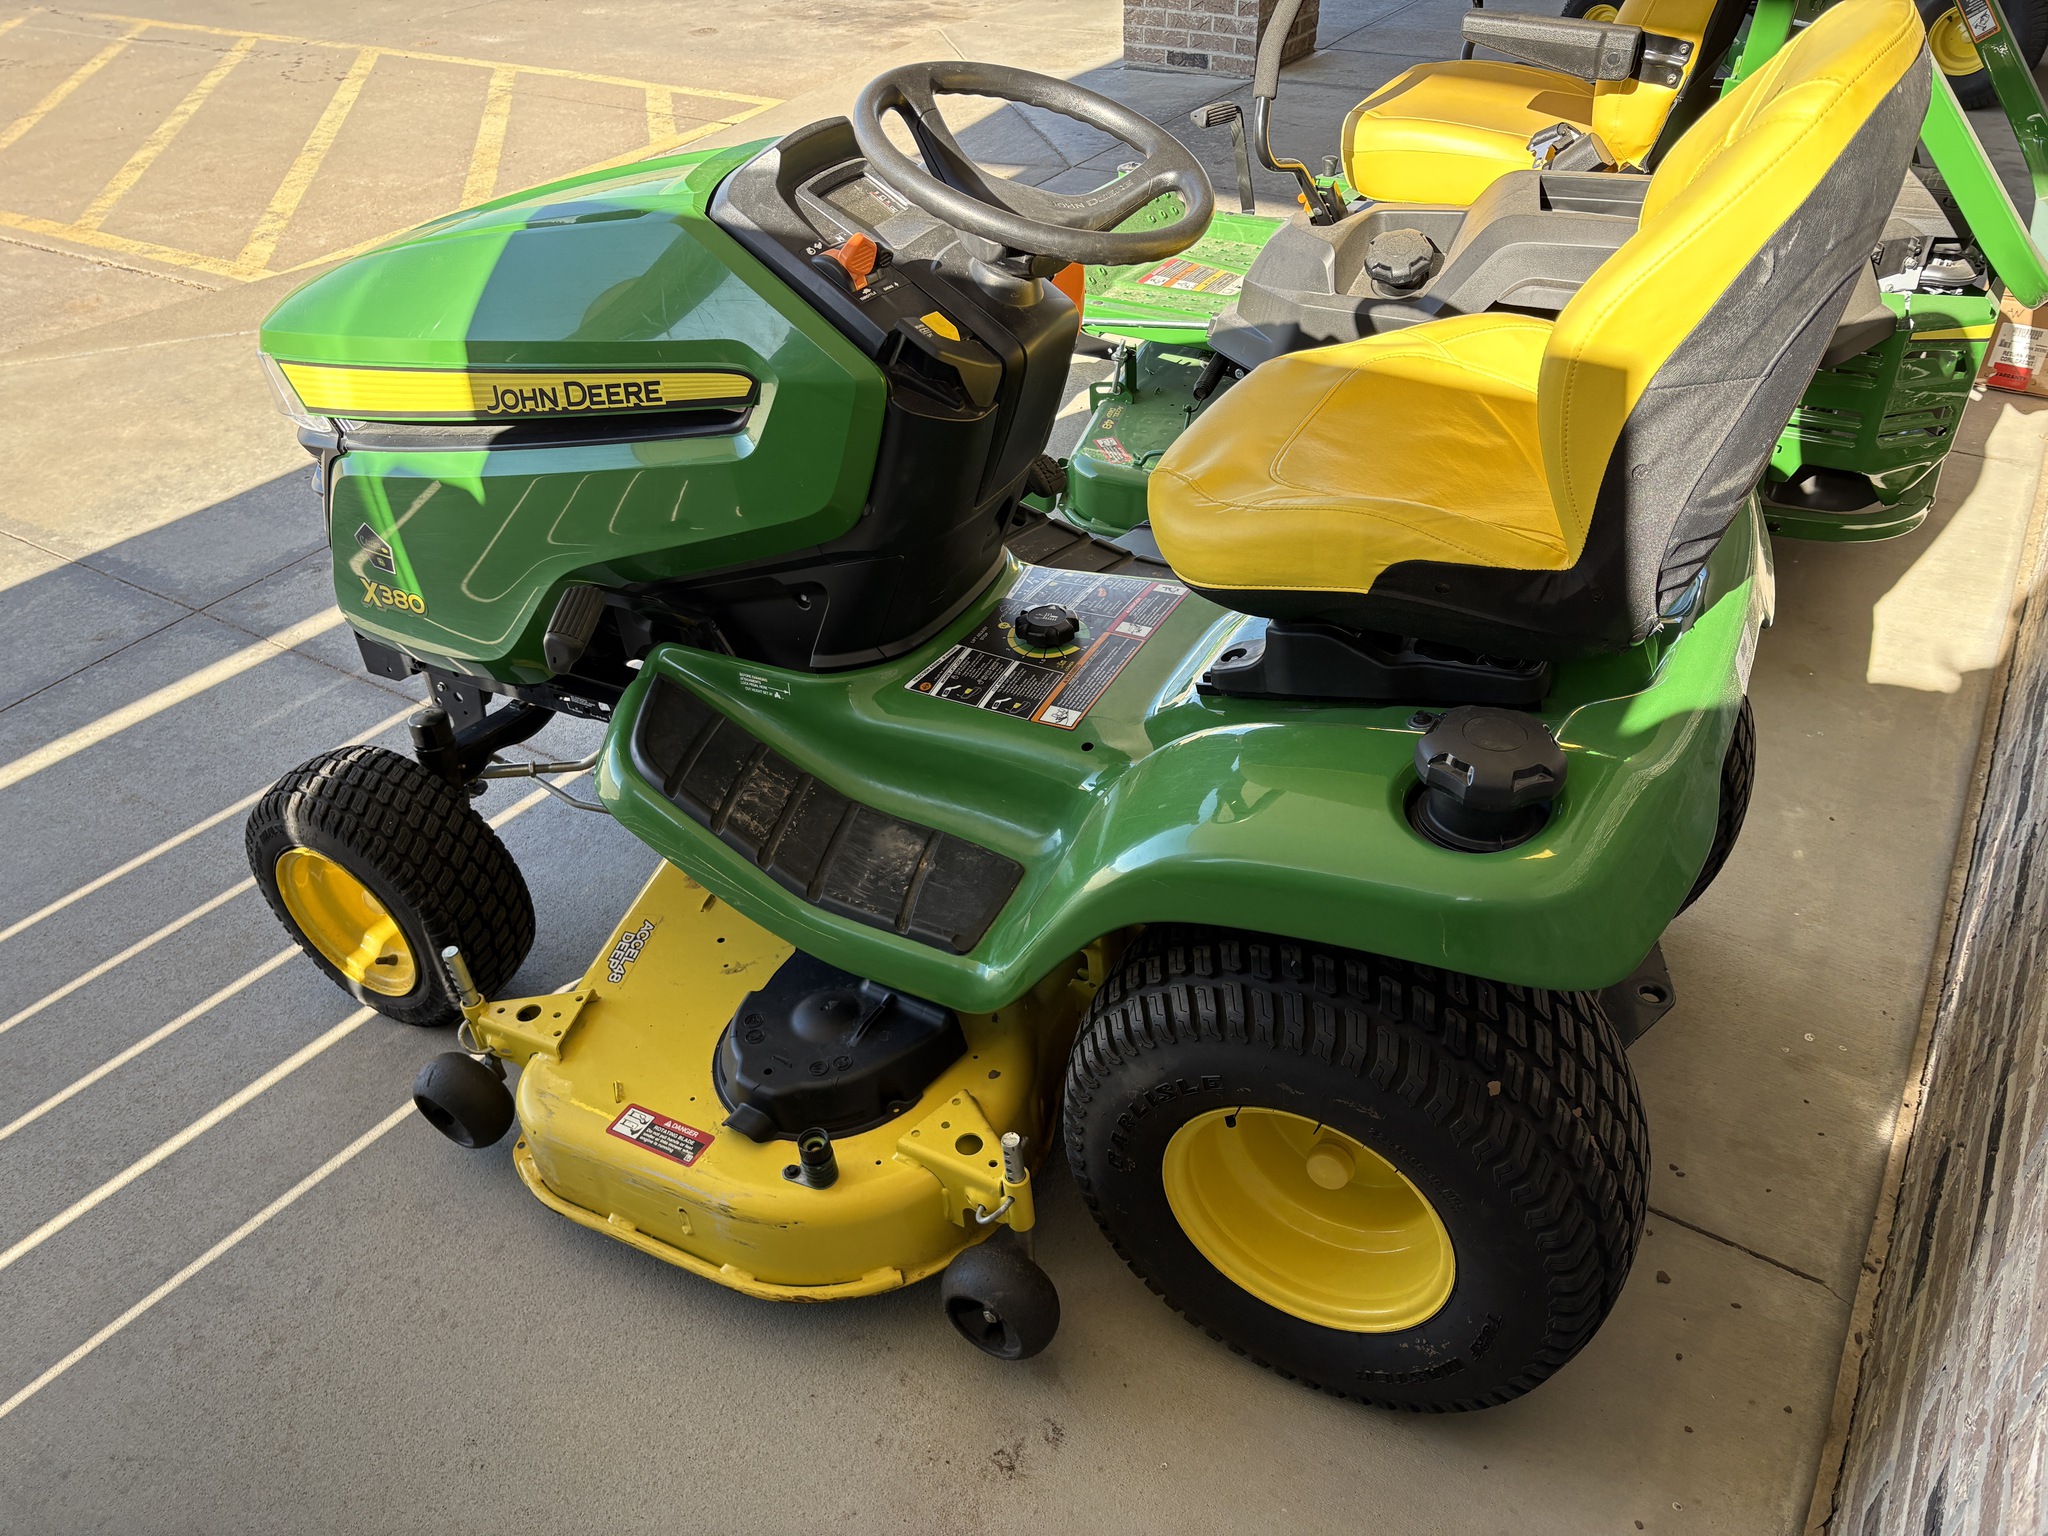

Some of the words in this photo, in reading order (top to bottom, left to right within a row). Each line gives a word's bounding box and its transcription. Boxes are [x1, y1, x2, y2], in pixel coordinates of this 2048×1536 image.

[487, 384, 560, 412] JOHN
[562, 380, 664, 408] DEERE
[1101, 419, 1115, 430] 48
[359, 577, 426, 614] X380
[607, 931, 636, 970] DEEP
[620, 919, 655, 965] ACCEL
[607, 963, 626, 983] 48
[653, 1125, 678, 1140] ROTATING
[677, 1134, 695, 1145] BLADE
[671, 1122, 700, 1138] DANGER
[1107, 1074, 1224, 1170] CARLISLE
[1468, 1311, 1504, 1362] TURF
[1355, 1356, 1467, 1386] MASTER
